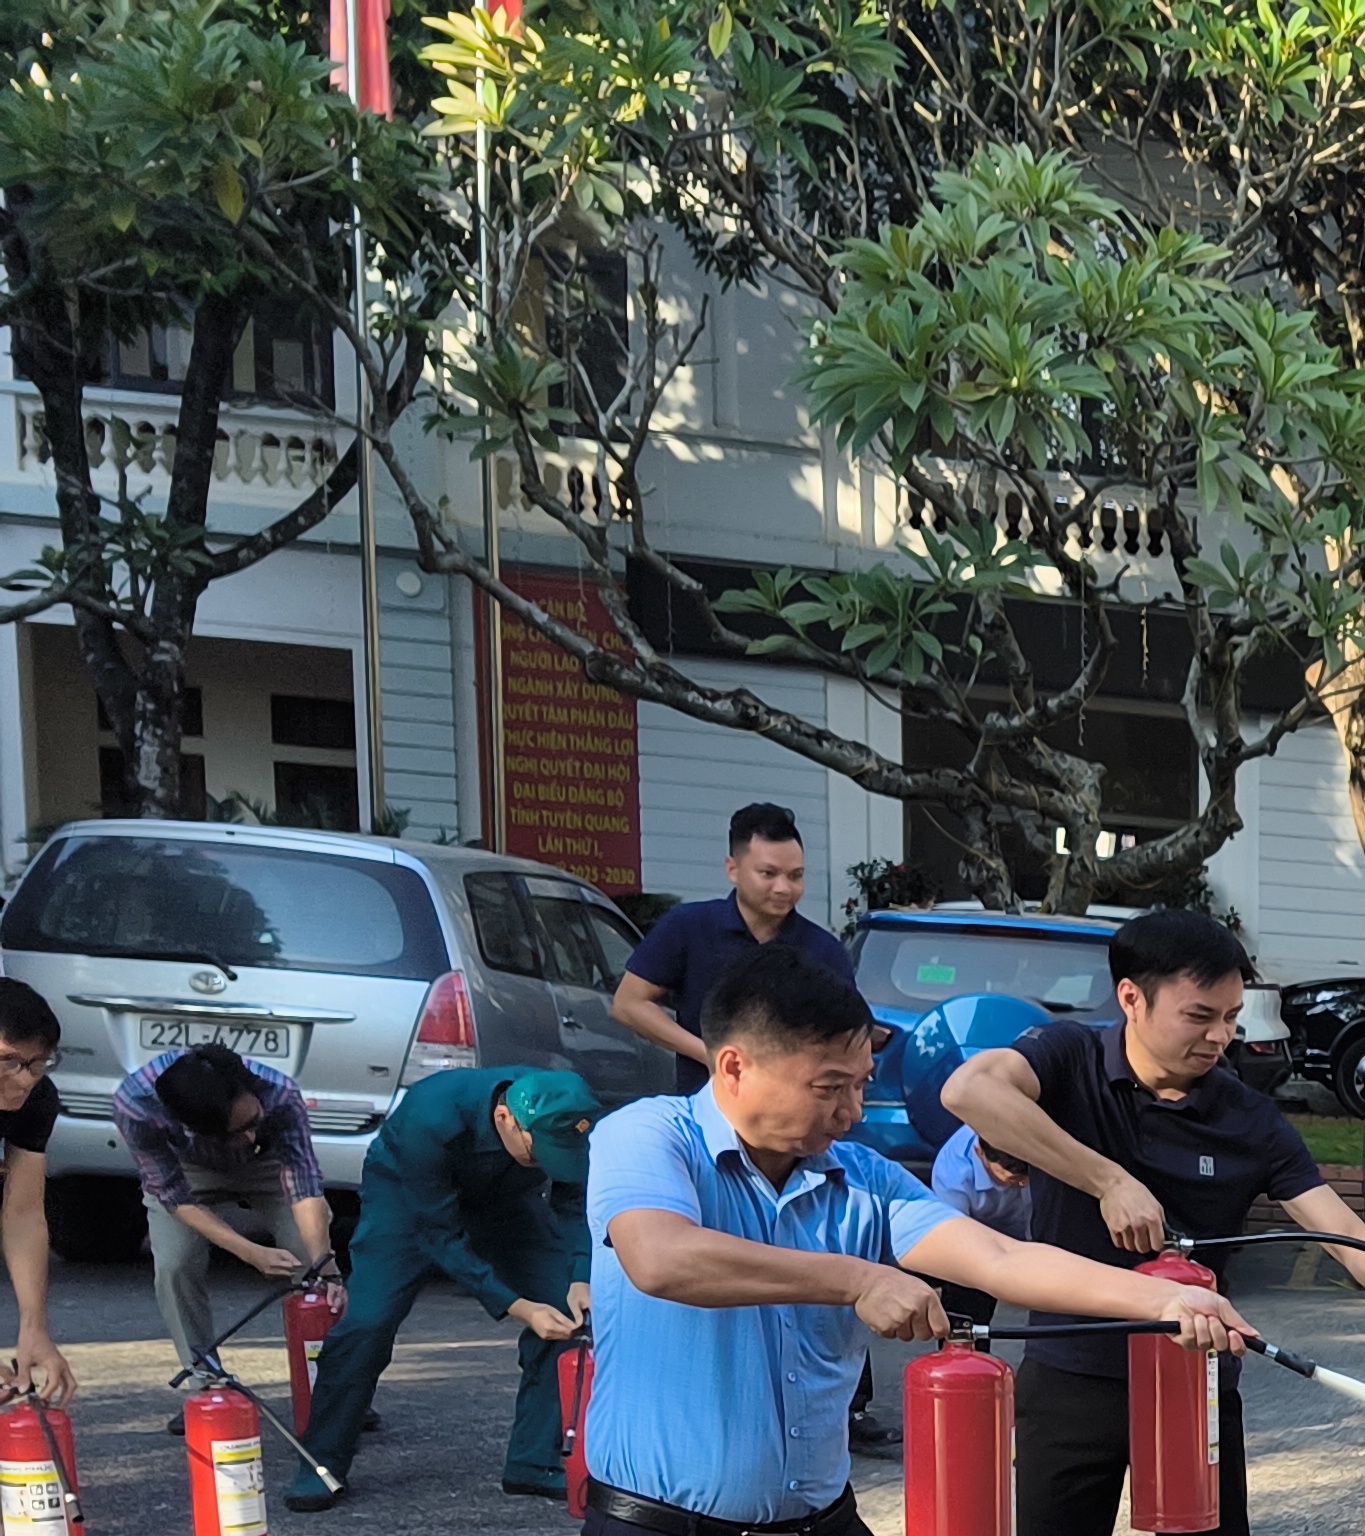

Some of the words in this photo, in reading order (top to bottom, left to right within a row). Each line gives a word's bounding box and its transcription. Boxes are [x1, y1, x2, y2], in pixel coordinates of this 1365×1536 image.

[553, 654, 579, 672] LAO
[541, 808, 583, 829] TUYÊN
[584, 813, 630, 834] QUANG
